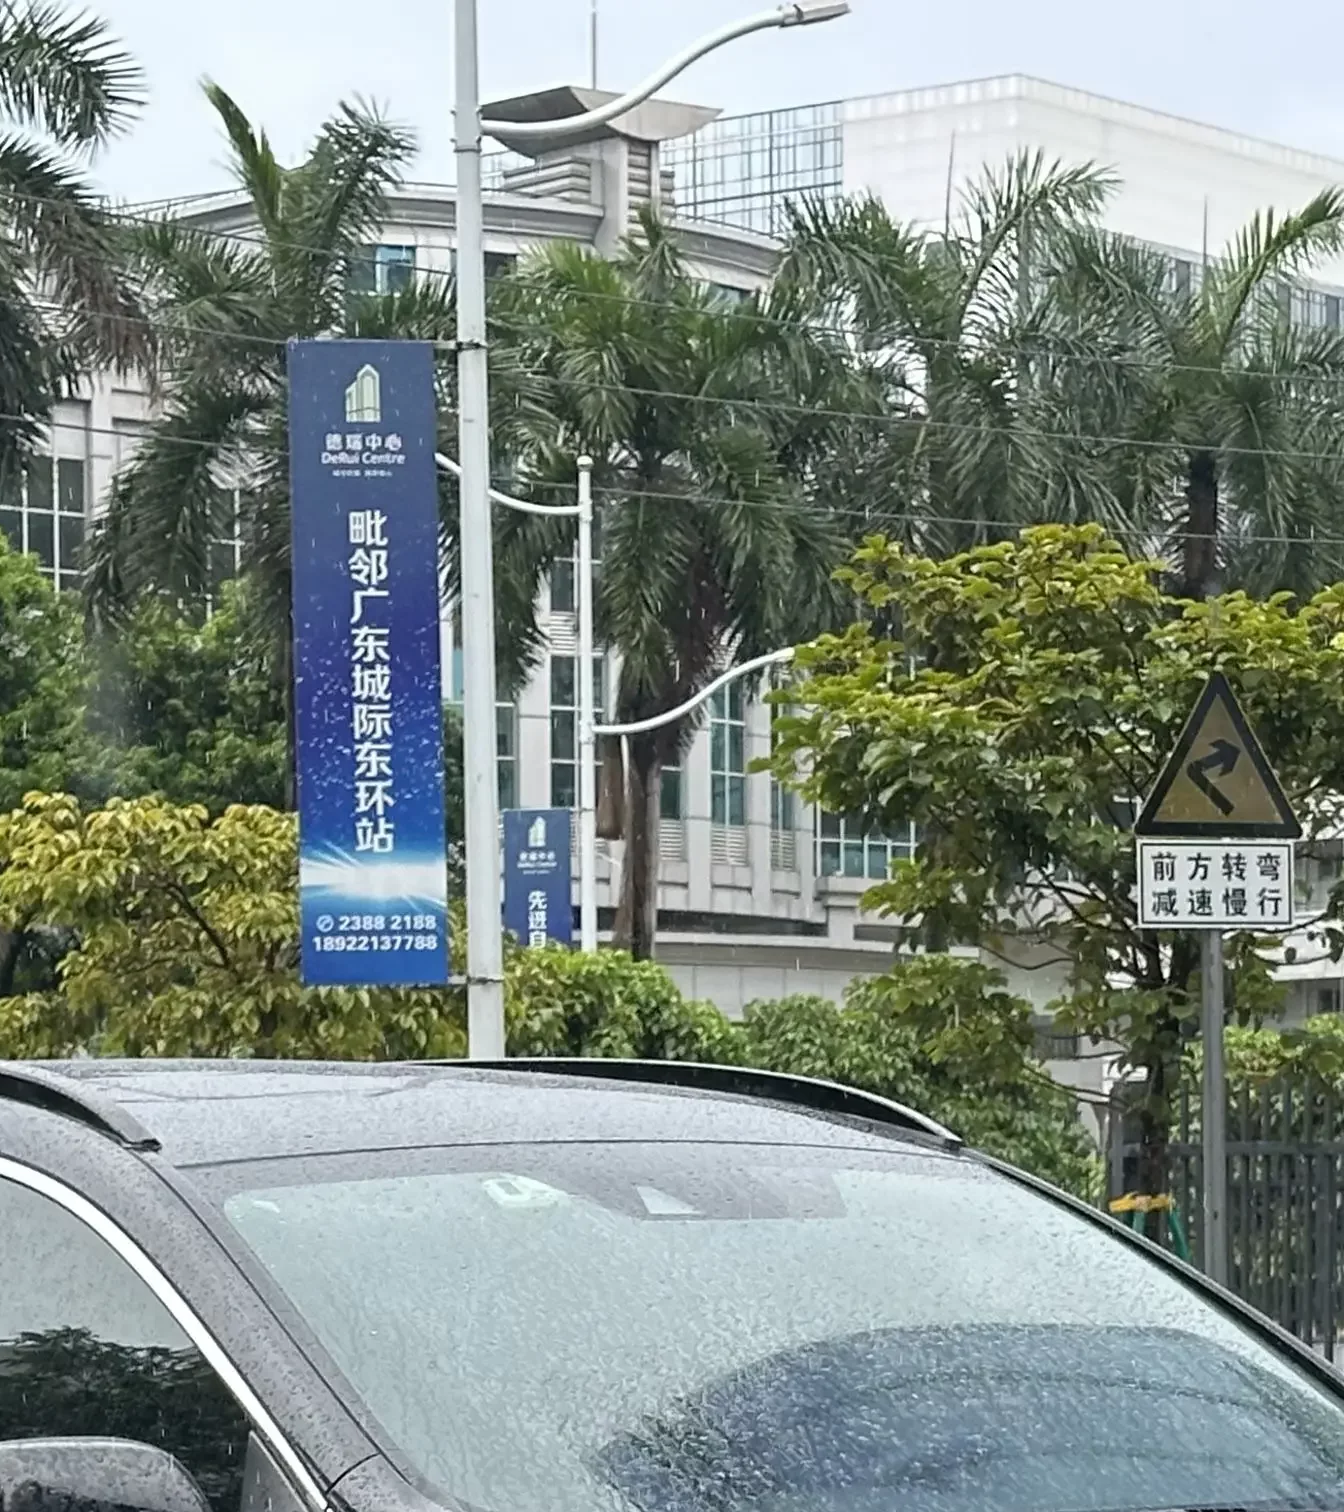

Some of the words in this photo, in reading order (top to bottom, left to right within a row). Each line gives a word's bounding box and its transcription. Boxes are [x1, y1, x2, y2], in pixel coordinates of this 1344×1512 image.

[362, 451, 406, 465] Centre
[348, 509, 395, 853] 毗邻广东城际东环站
[1151, 851, 1282, 882] 前方转弯
[1150, 887, 1283, 917] 减速慢行
[338, 915, 386, 931] 2388
[390, 914, 437, 931] 2188
[312, 935, 438, 952] 18922137788
